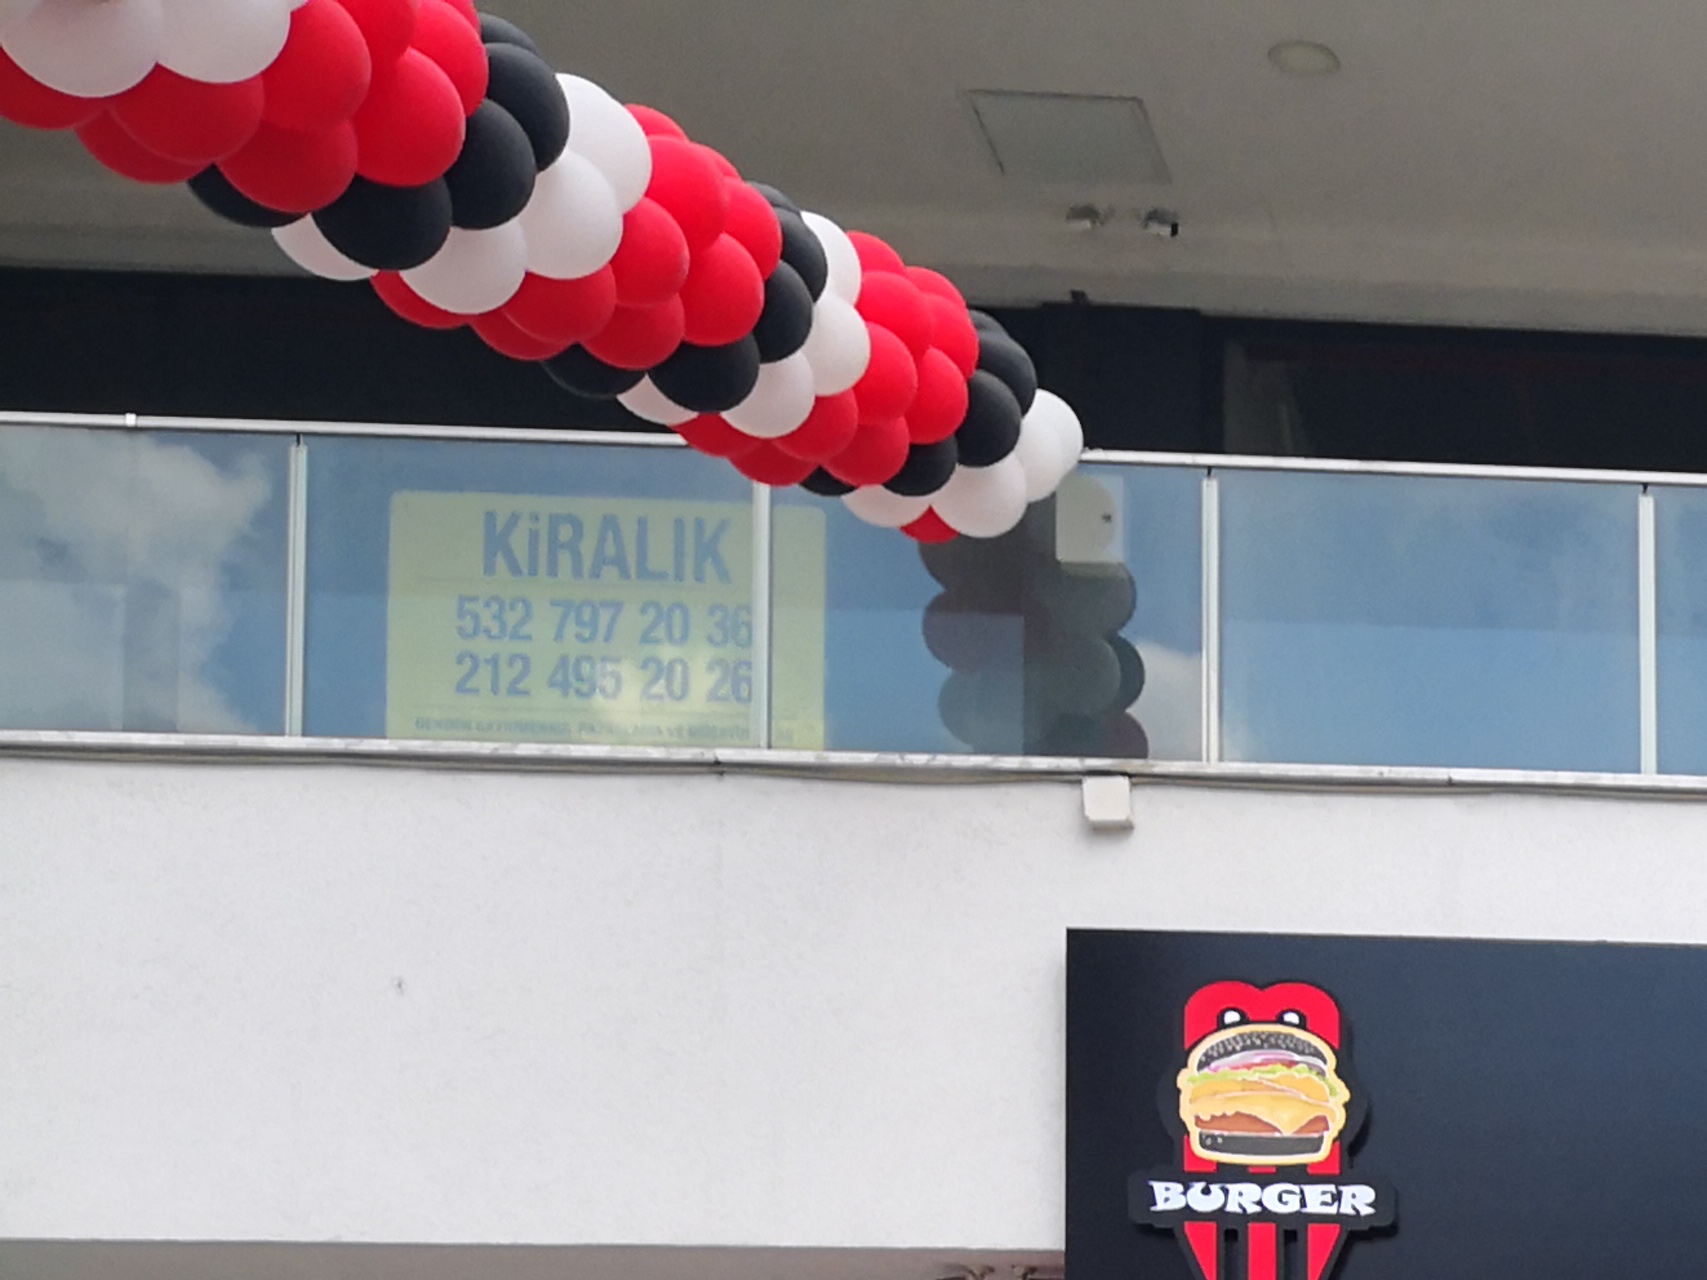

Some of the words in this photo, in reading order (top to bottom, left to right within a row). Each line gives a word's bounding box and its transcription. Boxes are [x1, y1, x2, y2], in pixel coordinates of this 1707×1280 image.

[455, 594, 533, 642] 532
[549, 599, 624, 644] 797
[638, 602, 691, 646] 20
[454, 650, 532, 698] 212
[547, 655, 624, 701] 495
[638, 657, 691, 702] 20
[1147, 1179, 1377, 1217] BURGER
